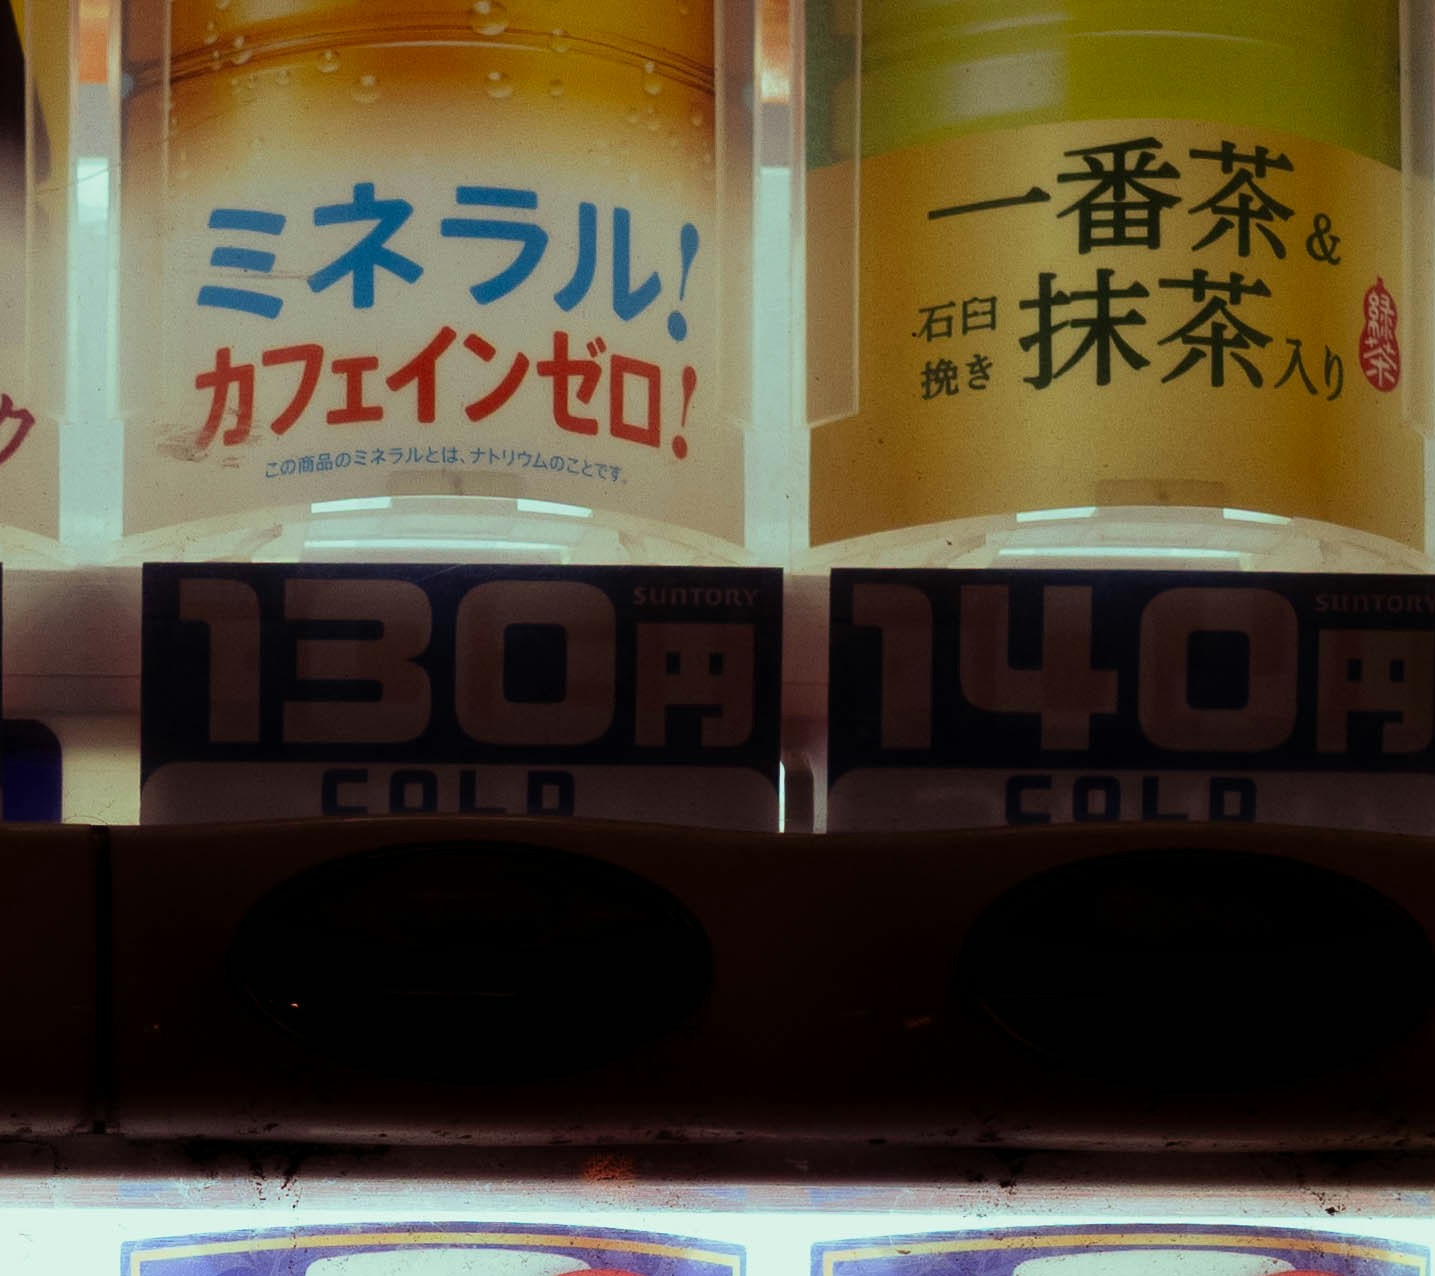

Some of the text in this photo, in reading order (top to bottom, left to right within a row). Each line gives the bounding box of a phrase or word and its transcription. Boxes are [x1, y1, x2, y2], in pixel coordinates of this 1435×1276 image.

[918, 295, 998, 343] 石臼
[921, 353, 994, 400] 挽き
[321, 769, 577, 818] COLD
[1005, 776, 1258, 825] COLD
